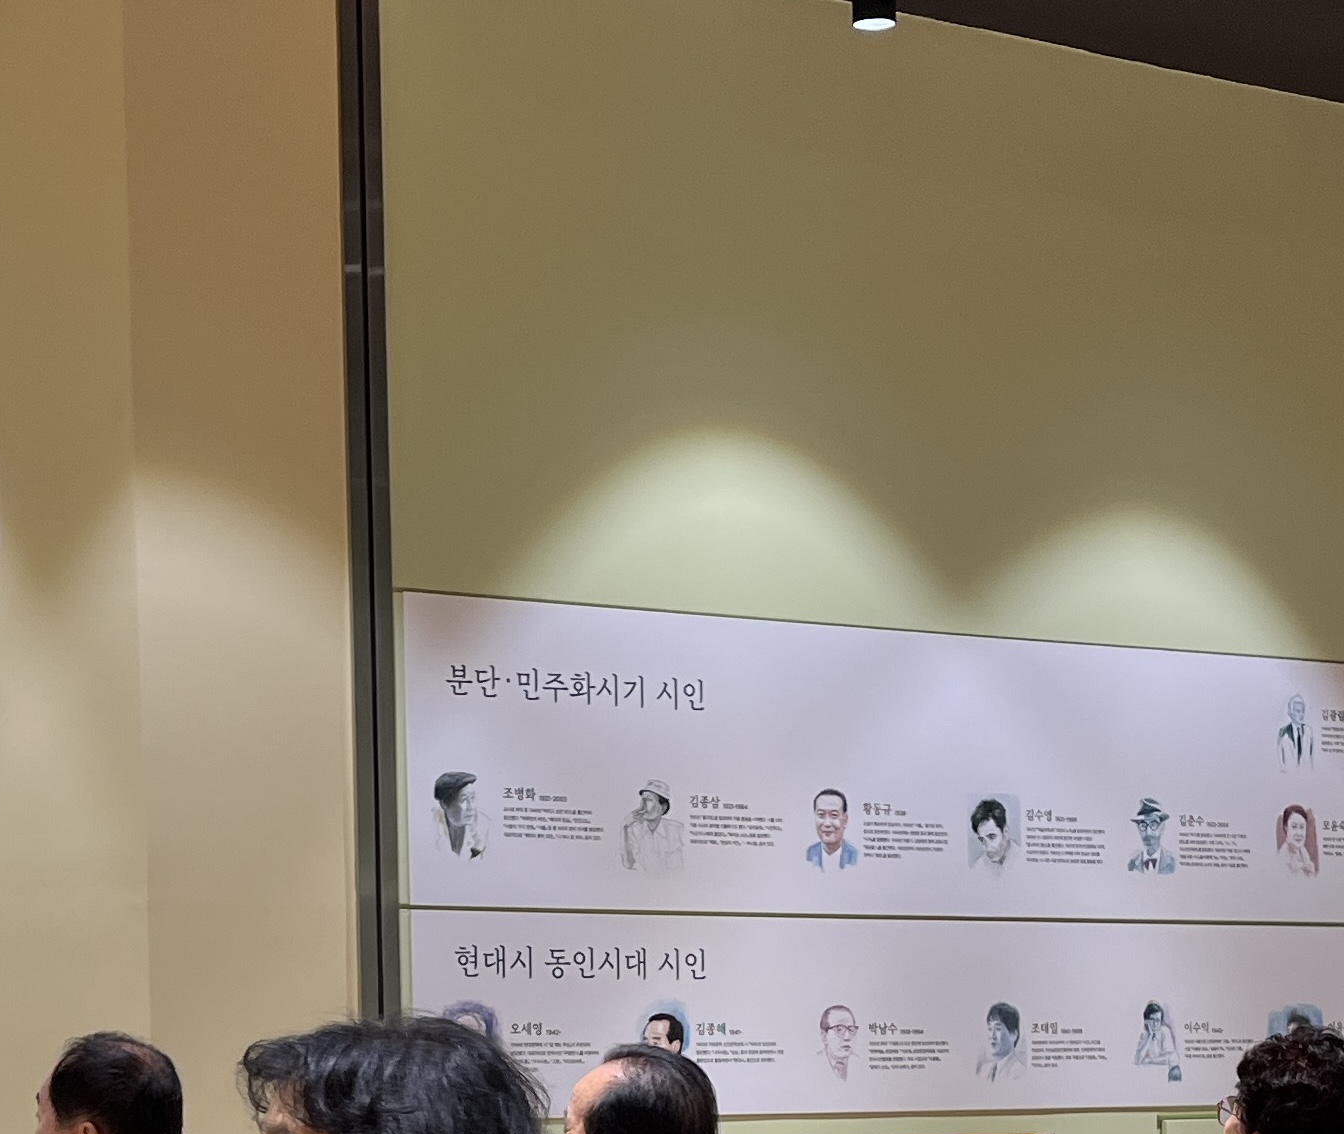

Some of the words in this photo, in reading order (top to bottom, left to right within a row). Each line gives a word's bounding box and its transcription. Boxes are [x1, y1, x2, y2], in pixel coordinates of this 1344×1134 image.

[445, 663, 645, 709] 분단·민주화시기
[656, 677, 705, 711] 시인
[503, 787, 537, 801] 조병화
[689, 795, 721, 809] 김종삼
[1026, 809, 1053, 822] 김수영
[1178, 814, 1205, 828] 김춘수
[455, 944, 533, 979] 현대시
[544, 946, 647, 981] 동인시대
[658, 947, 707, 981] 시인
[510, 1022, 543, 1035] 오세영
[696, 1022, 726, 1036] 김종해
[868, 1022, 898, 1035] 박남수
